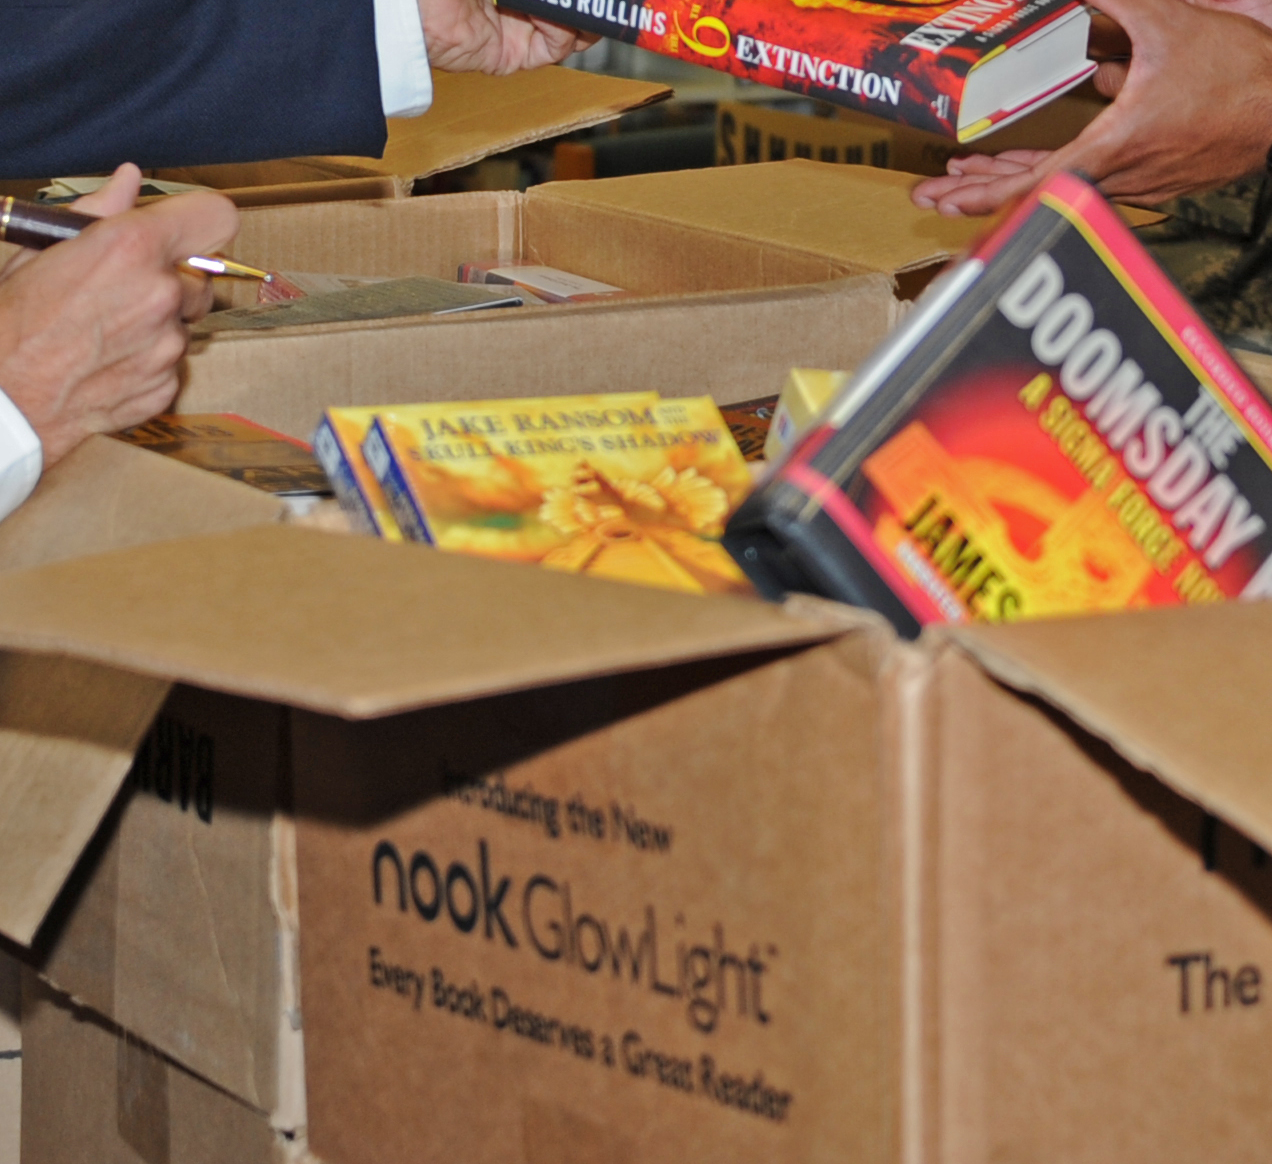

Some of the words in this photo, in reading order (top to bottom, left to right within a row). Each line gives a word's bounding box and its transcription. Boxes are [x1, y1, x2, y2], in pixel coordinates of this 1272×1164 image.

[673, 10, 731, 58] 6
[735, 34, 902, 106] EXTINCTION
[407, 439, 496, 461] SKULL
[504, 436, 595, 457] KING'S
[600, 427, 720, 452] SHADOW
[420, 413, 508, 441] JAKE
[512, 407, 657, 433] RANSOM
[995, 252, 1266, 571] DOOMSDAY
[1182, 384, 1246, 471] THE
[1017, 371, 1053, 413] A
[1038, 394, 1116, 492] SIGMA
[1106, 479, 1184, 574] FORCE
[903, 495, 1022, 623] JAMES
[566, 792, 606, 839] the
[610, 800, 672, 852] New
[371, 838, 518, 949] nook
[1166, 950, 1262, 1013] The
[368, 946, 426, 1011] Every
[431, 967, 488, 1023] Book
[490, 986, 595, 1061] Deserves
[620, 1030, 694, 1092] Great
[696, 1053, 794, 1125] Reader
